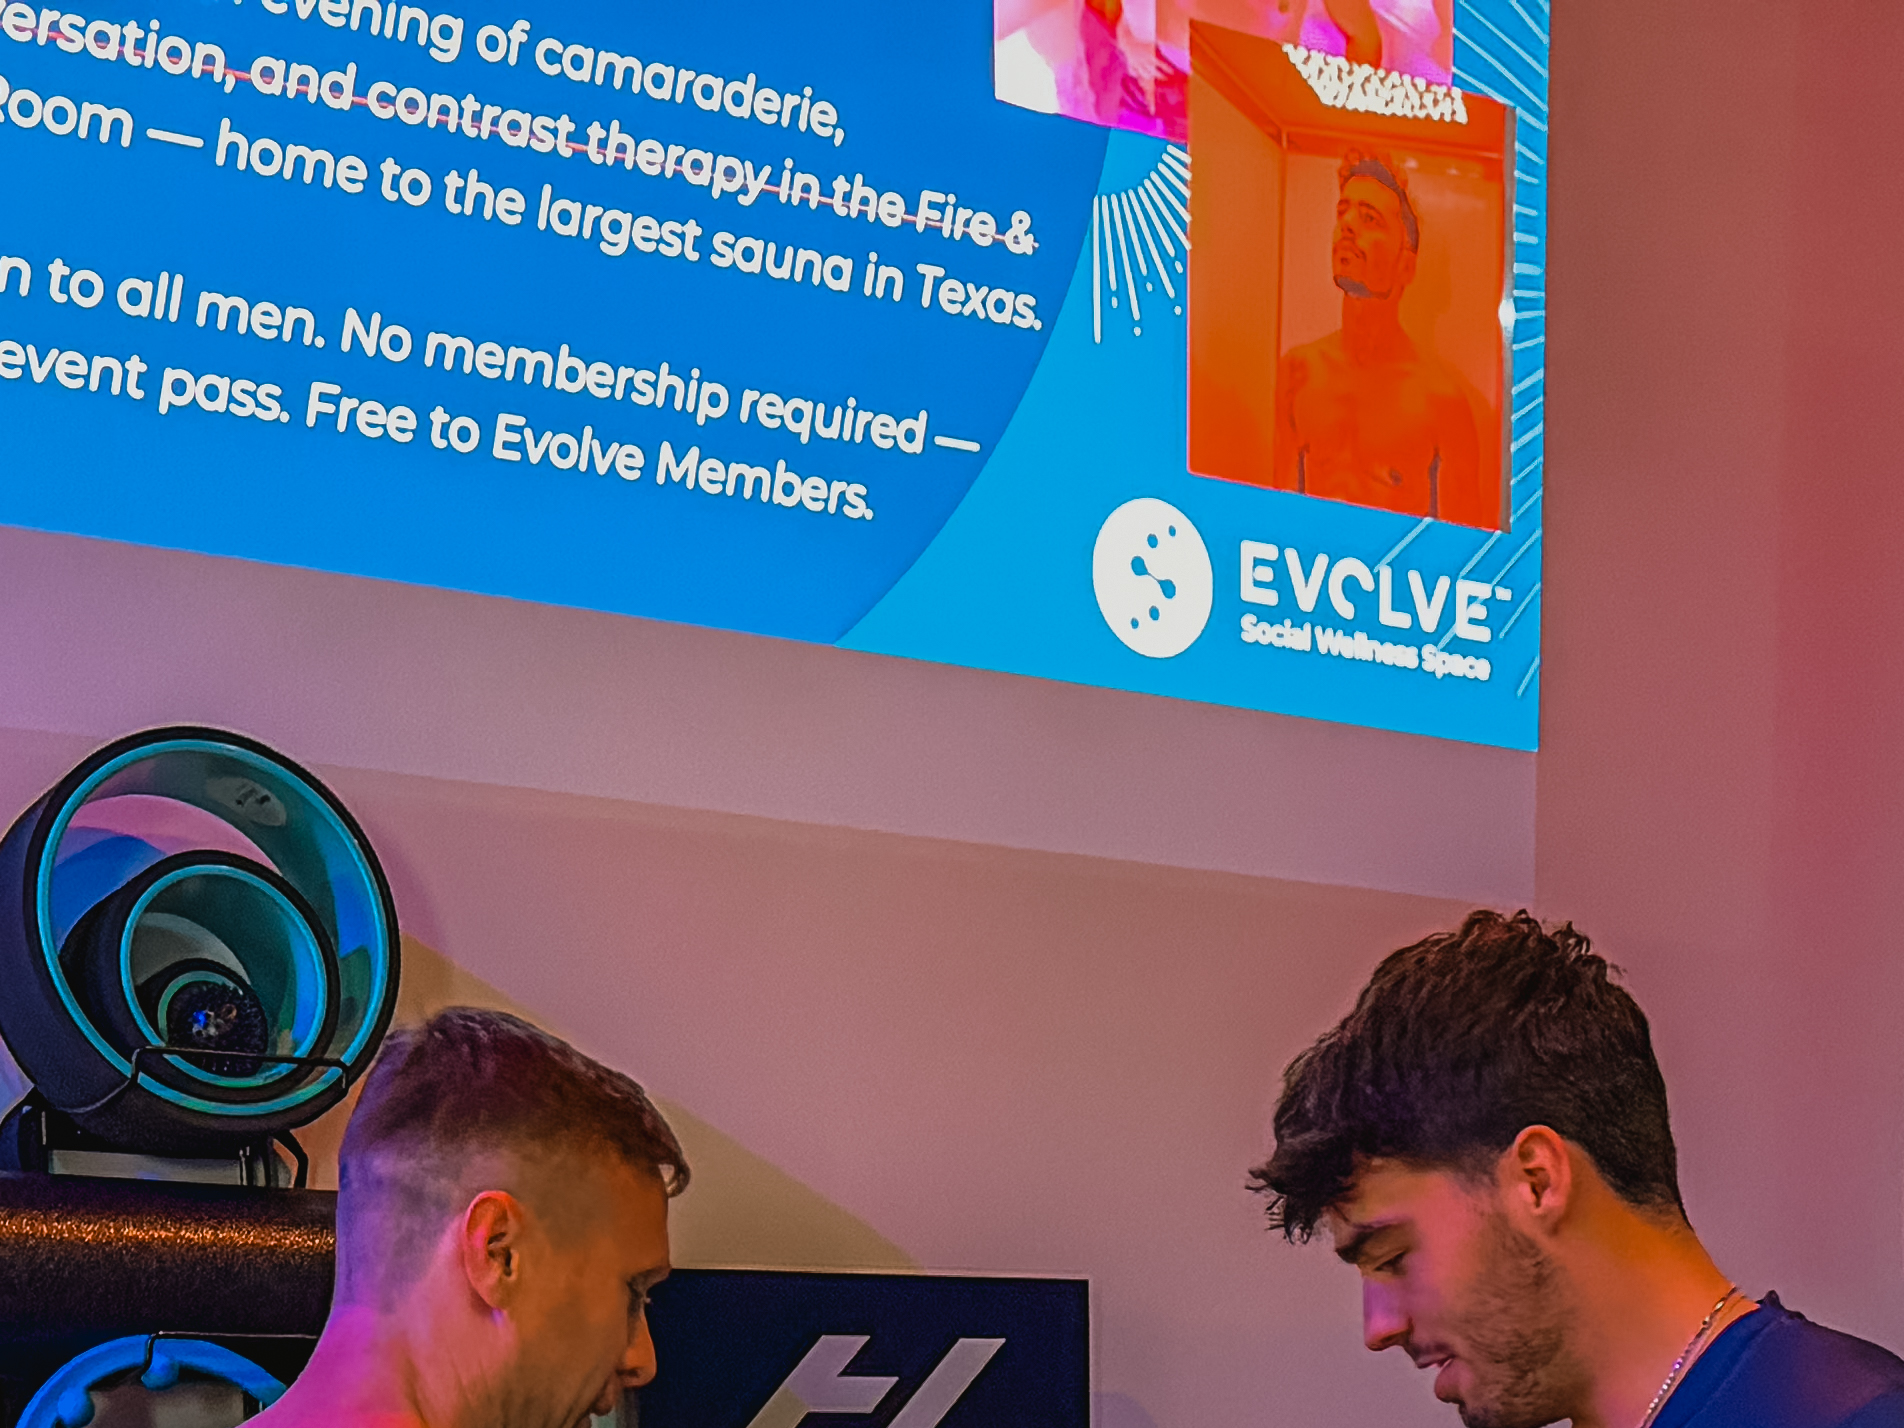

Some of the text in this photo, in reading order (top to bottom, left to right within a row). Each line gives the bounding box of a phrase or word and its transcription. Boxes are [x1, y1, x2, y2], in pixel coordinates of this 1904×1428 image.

[249, 55, 358, 111] and
[366, 81, 576, 159] contrast
[584, 119, 774, 207] therapy
[779, 157, 822, 211] in
[832, 172, 906, 228] the
[914, 188, 998, 247] Fire
[1004, 208, 1038, 256] &
[475, 18, 532, 67] of
[534, 36, 846, 148] camaraderie,
[214, 116, 369, 195] home
[378, 156, 433, 208] to
[443, 168, 527, 226] the
[536, 182, 703, 263] largest
[709, 230, 854, 293] sauna
[862, 250, 905, 303] in
[915, 262, 1043, 332] Texas.
[46, 257, 105, 309] to
[115, 270, 185, 324] all
[194, 290, 326, 349] men.
[339, 306, 413, 363] No
[423, 330, 730, 427] membership
[738, 388, 929, 455] required
[157, 366, 291, 424] pass.
[305, 380, 419, 444] Free
[428, 404, 481, 454] to
[491, 412, 646, 482] Evolve
[655, 439, 875, 521] Members.
[1239, 539, 1493, 643] EVOLVE
[1240, 613, 1492, 681] Social Wellness Space
